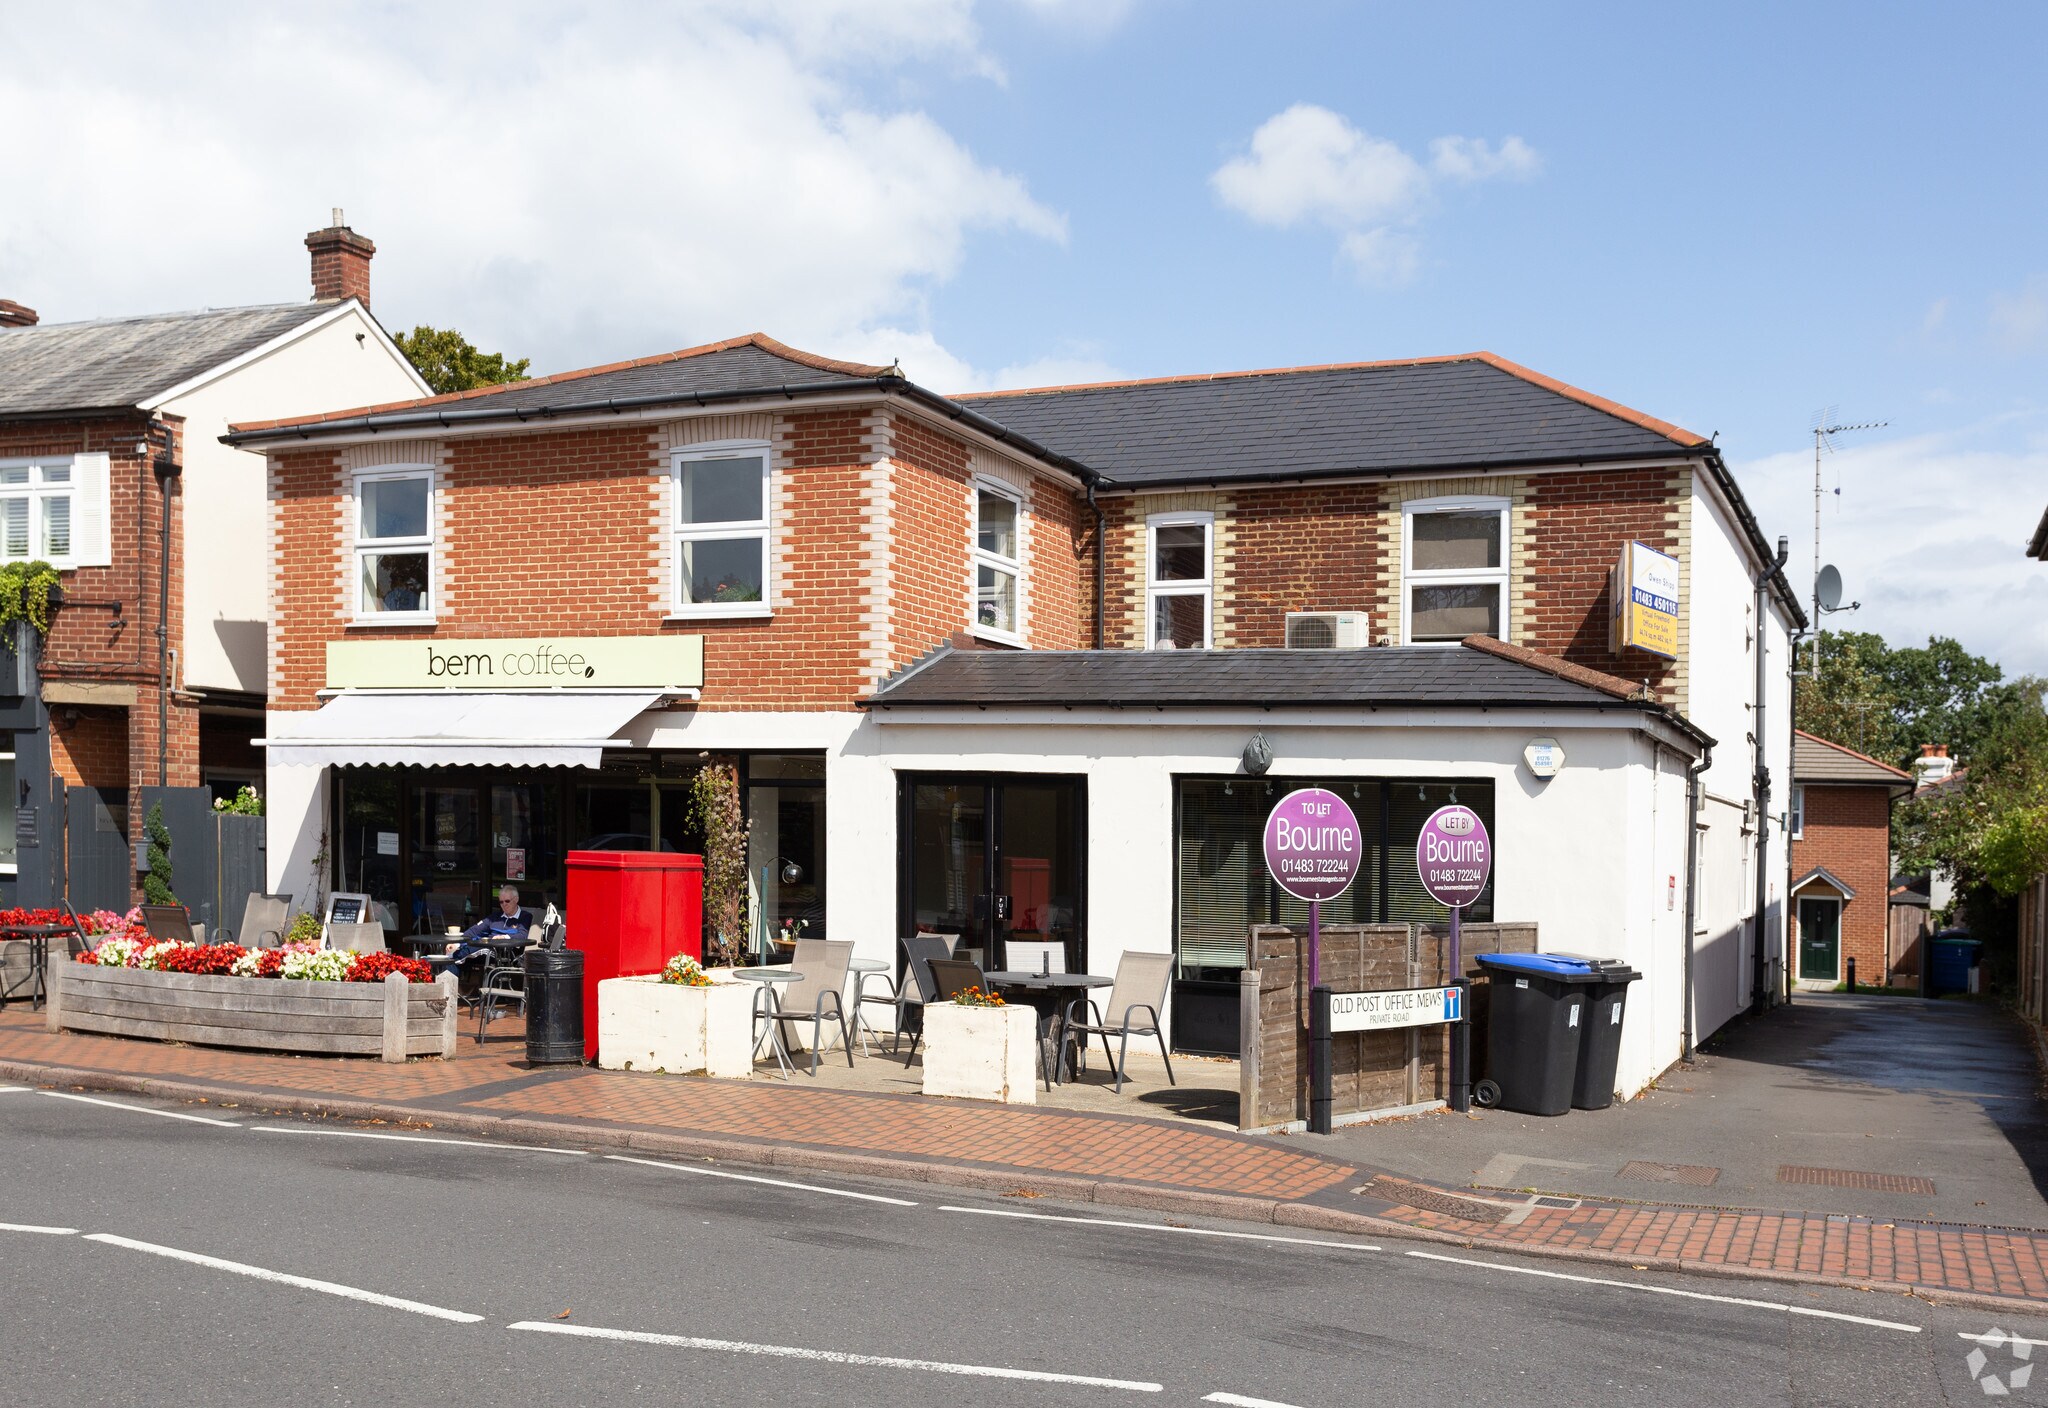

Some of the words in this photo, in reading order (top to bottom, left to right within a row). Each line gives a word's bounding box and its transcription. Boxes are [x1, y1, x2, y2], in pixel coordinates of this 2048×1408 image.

[1649, 573, 1661, 584] Owen
[1635, 590, 1652, 607] 01483
[1654, 597, 1676, 614] 450115
[1643, 620, 1653, 629] Office
[1660, 625, 1669, 634] Sale
[427, 647, 494, 676] bem
[502, 645, 586, 676] coffee
[1301, 802, 1315, 815] TO
[1317, 802, 1331, 815] LET
[1445, 817, 1460, 829] LET
[1461, 817, 1470, 829] BY
[1276, 817, 1353, 852] Bourne
[1426, 832, 1484, 863] Bourne
[1281, 858, 1314, 873] 01483
[1316, 859, 1349, 873] 722244
[1430, 869, 1456, 882] 01483
[1457, 869, 1481, 882] 722244
[1332, 997, 1354, 1014] OLD
[1356, 995, 1381, 1013] POST
[1384, 993, 1414, 1011] OFFICE
[1416, 991, 1443, 1008] MEWS
[1369, 1013, 1391, 1024] PRIVATE
[1392, 1012, 1410, 1023] ROAD
